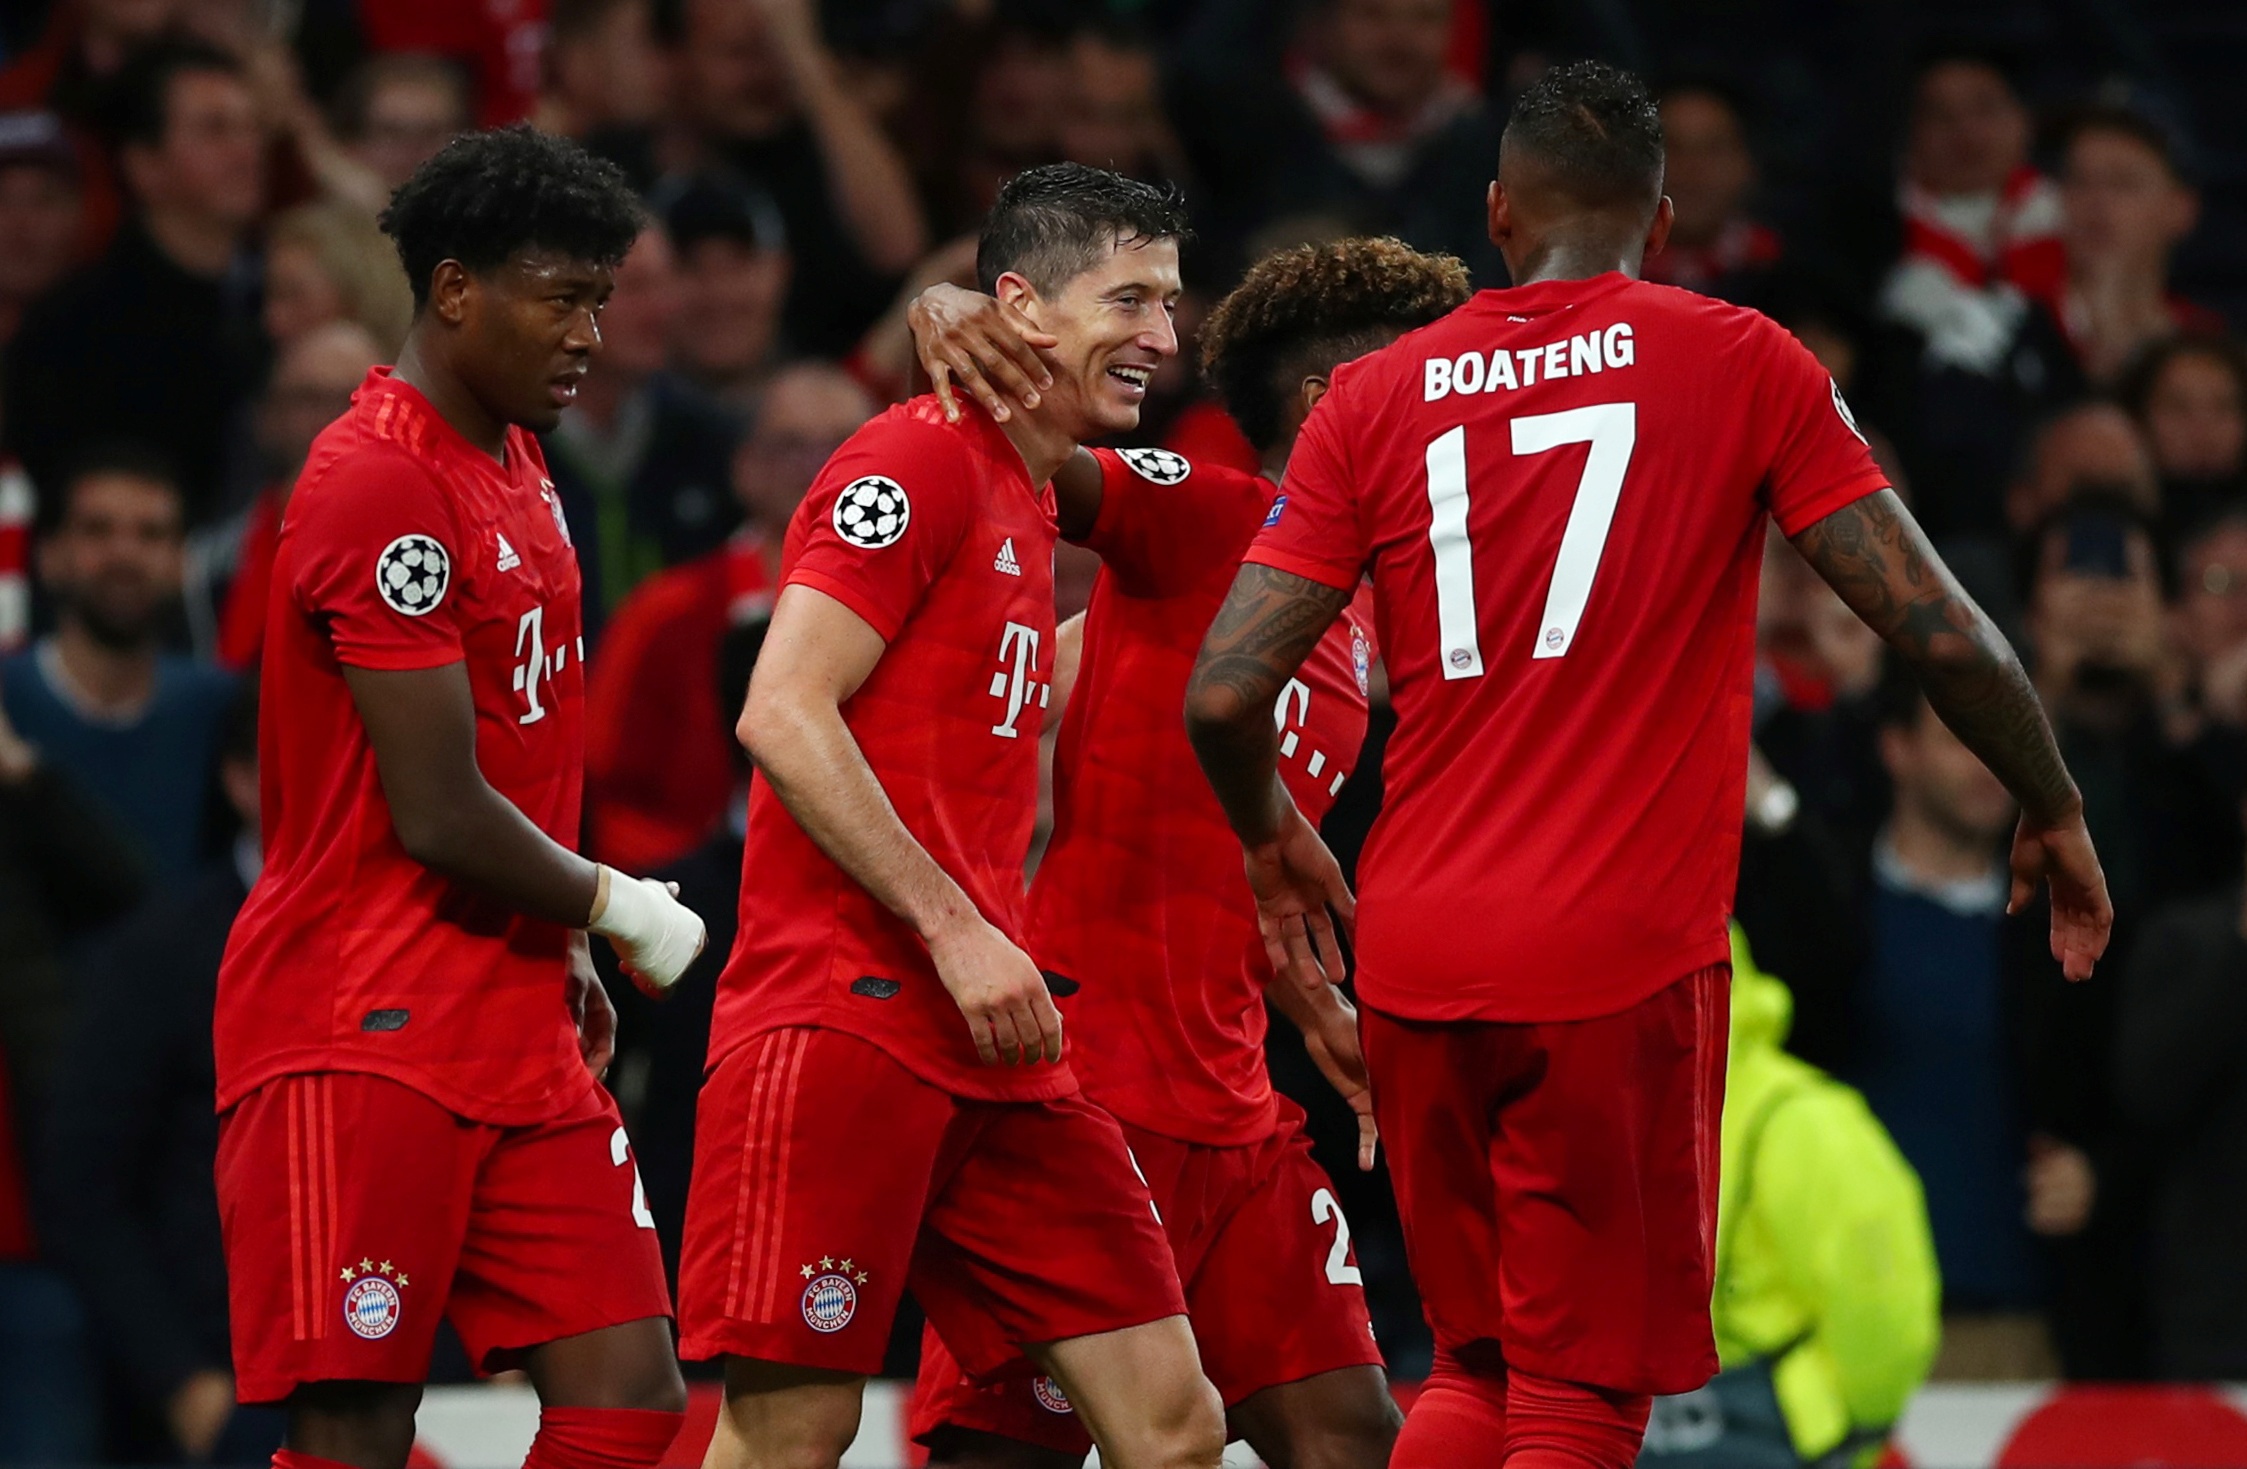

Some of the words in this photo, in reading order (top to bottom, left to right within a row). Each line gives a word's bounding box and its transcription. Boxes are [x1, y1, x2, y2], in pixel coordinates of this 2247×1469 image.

[1424, 322, 1635, 402] BOATENG
[1426, 402, 1636, 680] 17
[1311, 1187, 1364, 1286] 2
[350, 1287, 363, 1303] FC
[362, 1281, 396, 1306] BAYERN
[808, 1284, 821, 1299] FC
[821, 1278, 853, 1301] BAYERN
